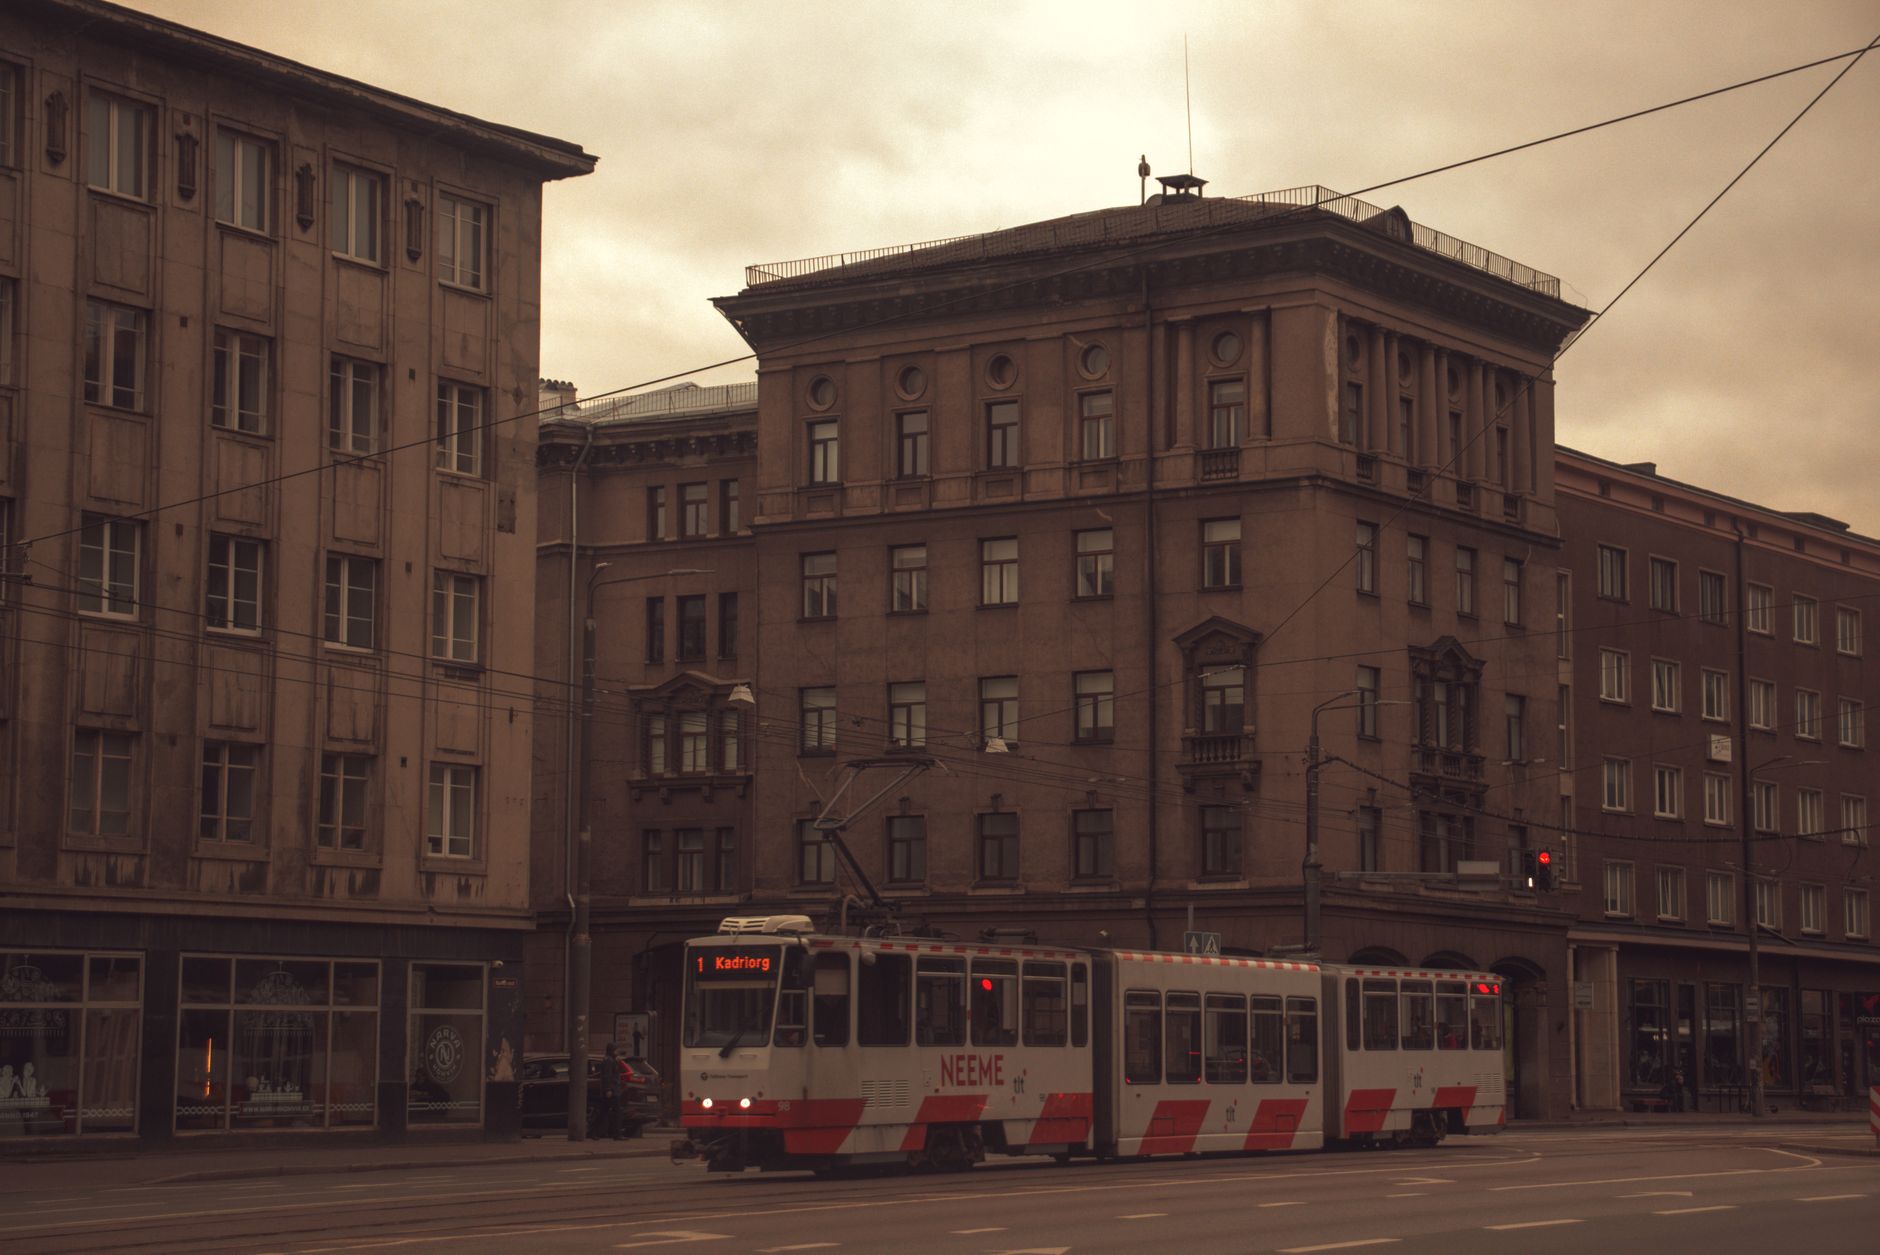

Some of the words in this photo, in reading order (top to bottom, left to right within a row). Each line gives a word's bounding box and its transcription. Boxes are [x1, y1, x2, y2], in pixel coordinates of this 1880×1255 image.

[697, 956, 704, 972] 1
[715, 955, 770, 972] Kadriorg
[430, 1028, 461, 1049] NARVA
[941, 1054, 1004, 1087] NEEME
